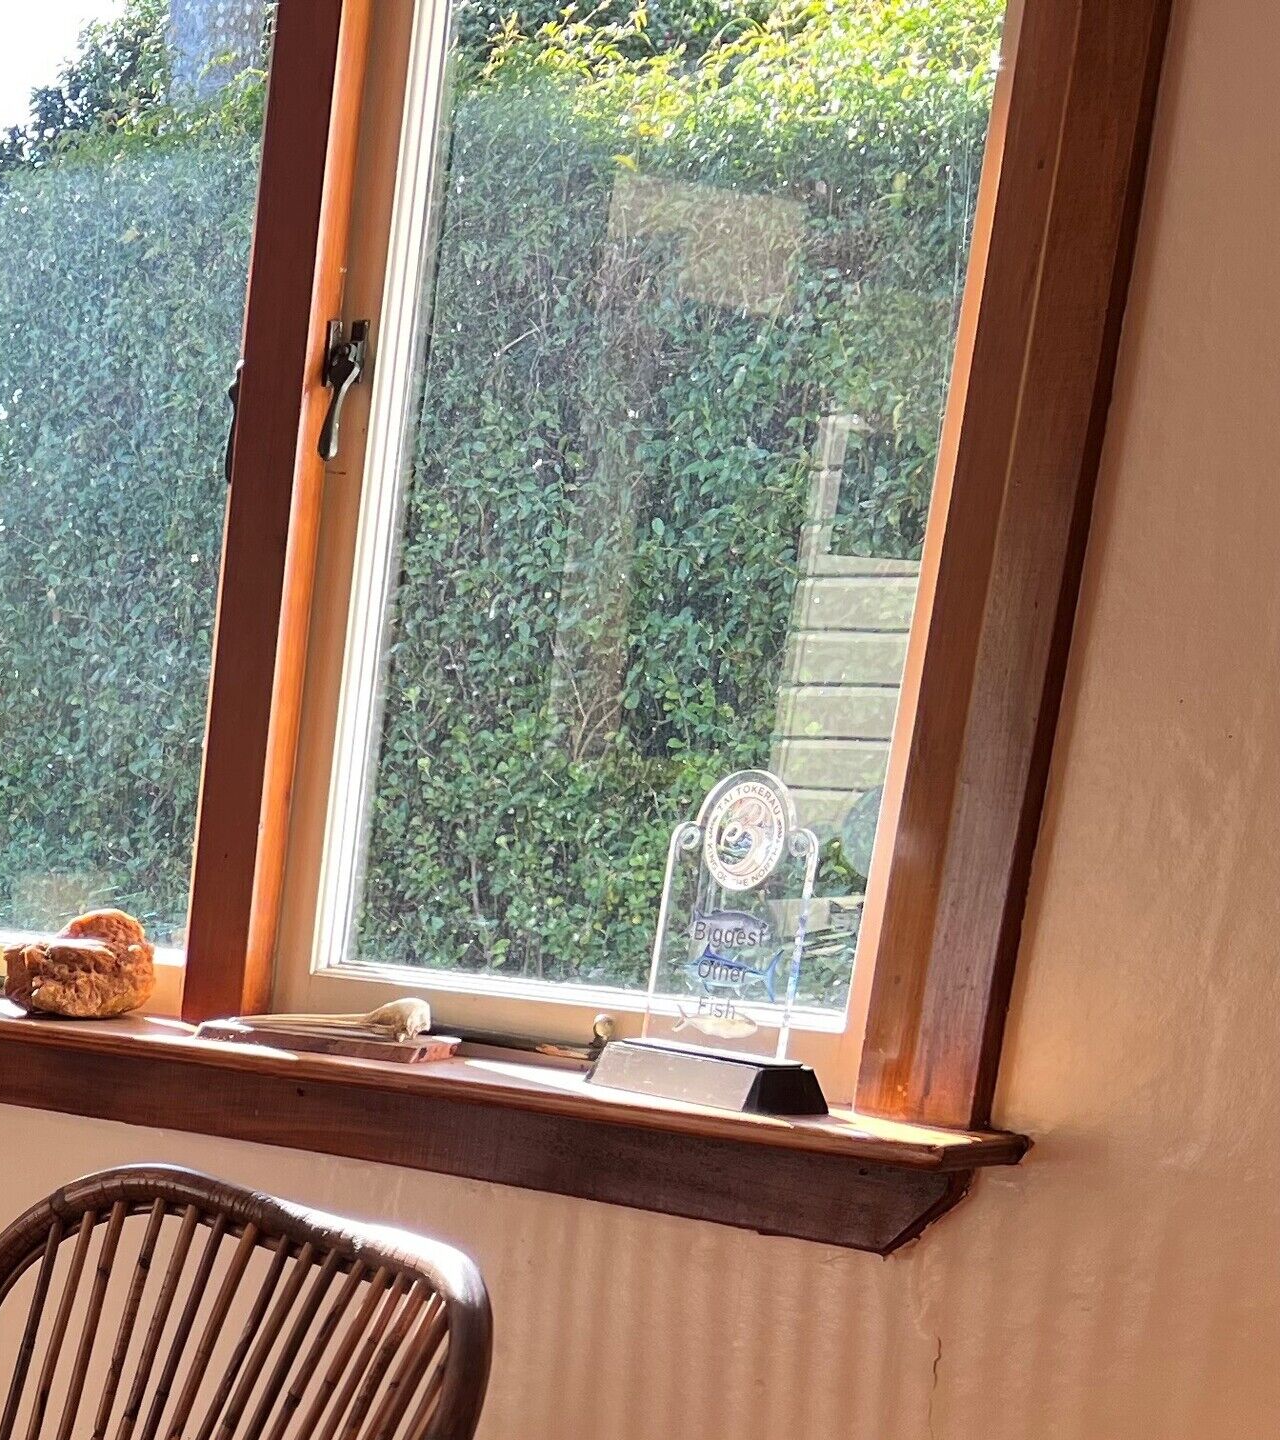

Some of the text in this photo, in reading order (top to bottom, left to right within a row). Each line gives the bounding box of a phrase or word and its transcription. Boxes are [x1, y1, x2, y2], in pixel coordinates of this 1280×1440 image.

[737, 784, 782, 816] TOKERAU
[693, 921, 768, 949] Biggest
[697, 958, 750, 984] Other
[697, 997, 737, 1021] Fish
